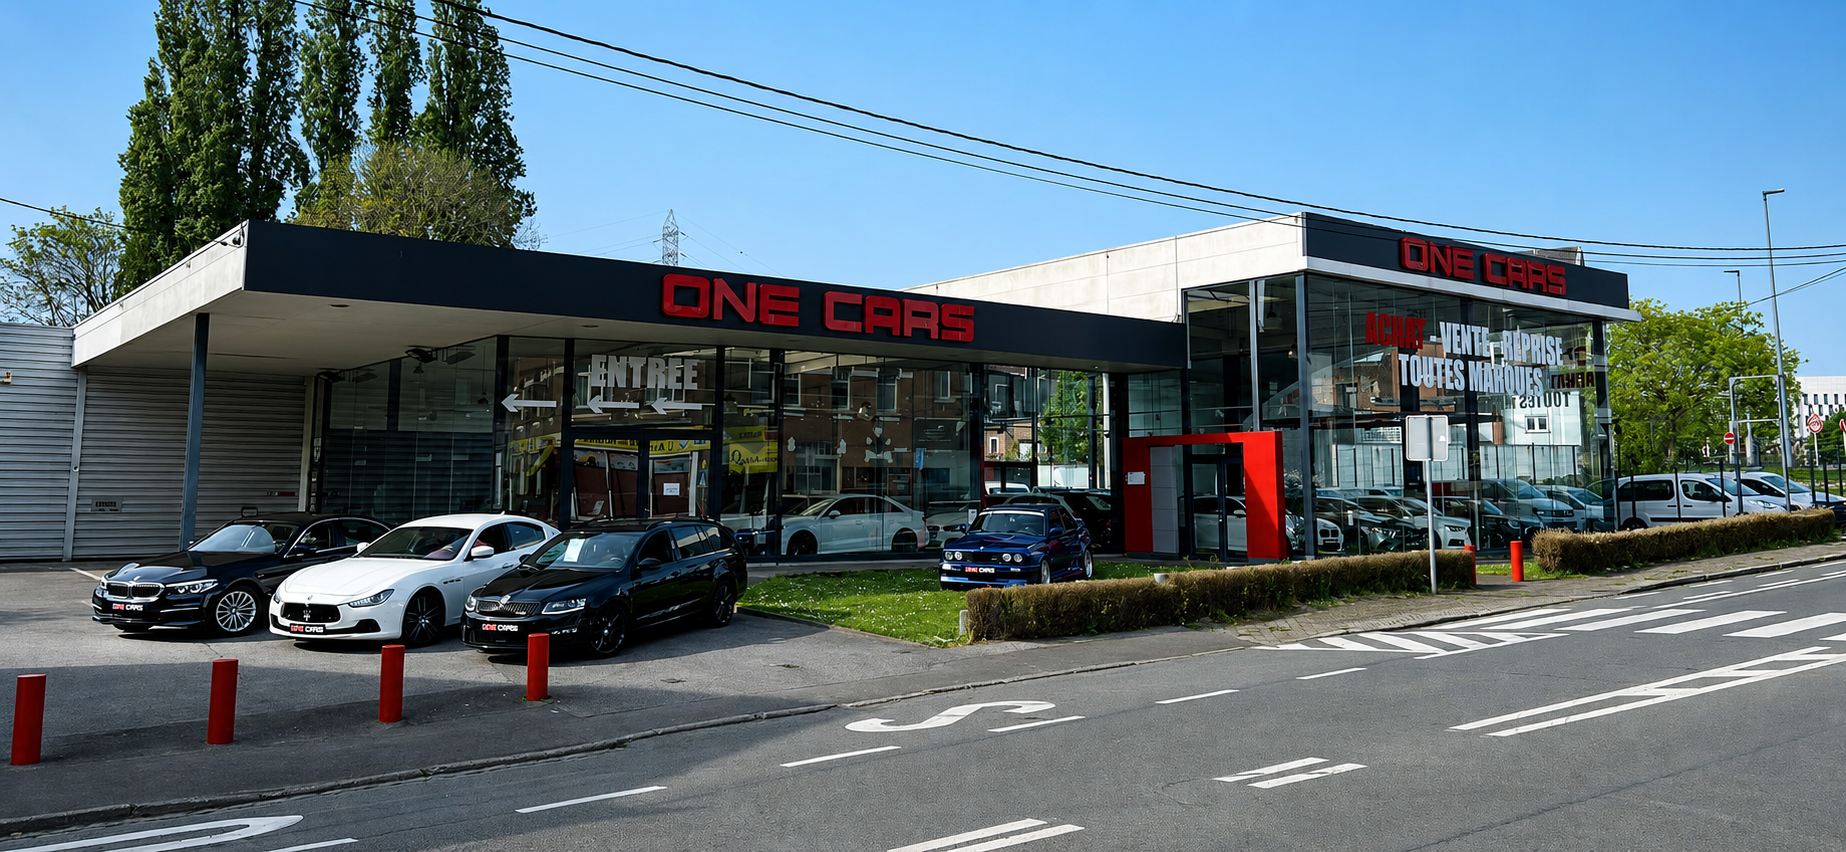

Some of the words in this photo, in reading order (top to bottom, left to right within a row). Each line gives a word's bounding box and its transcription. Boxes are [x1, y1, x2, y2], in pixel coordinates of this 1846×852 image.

[1401, 237, 1474, 280] ONE
[1482, 253, 1566, 295] CARS
[662, 273, 799, 327] ONE
[823, 291, 975, 342] CARS
[1365, 312, 1426, 349] ACHAT
[1439, 321, 1491, 358] VENTE
[1502, 330, 1563, 366] REPRISE
[591, 354, 699, 390] ENTREE
[1398, 353, 1465, 391] TOUTES
[1468, 360, 1544, 396] MARQUES
